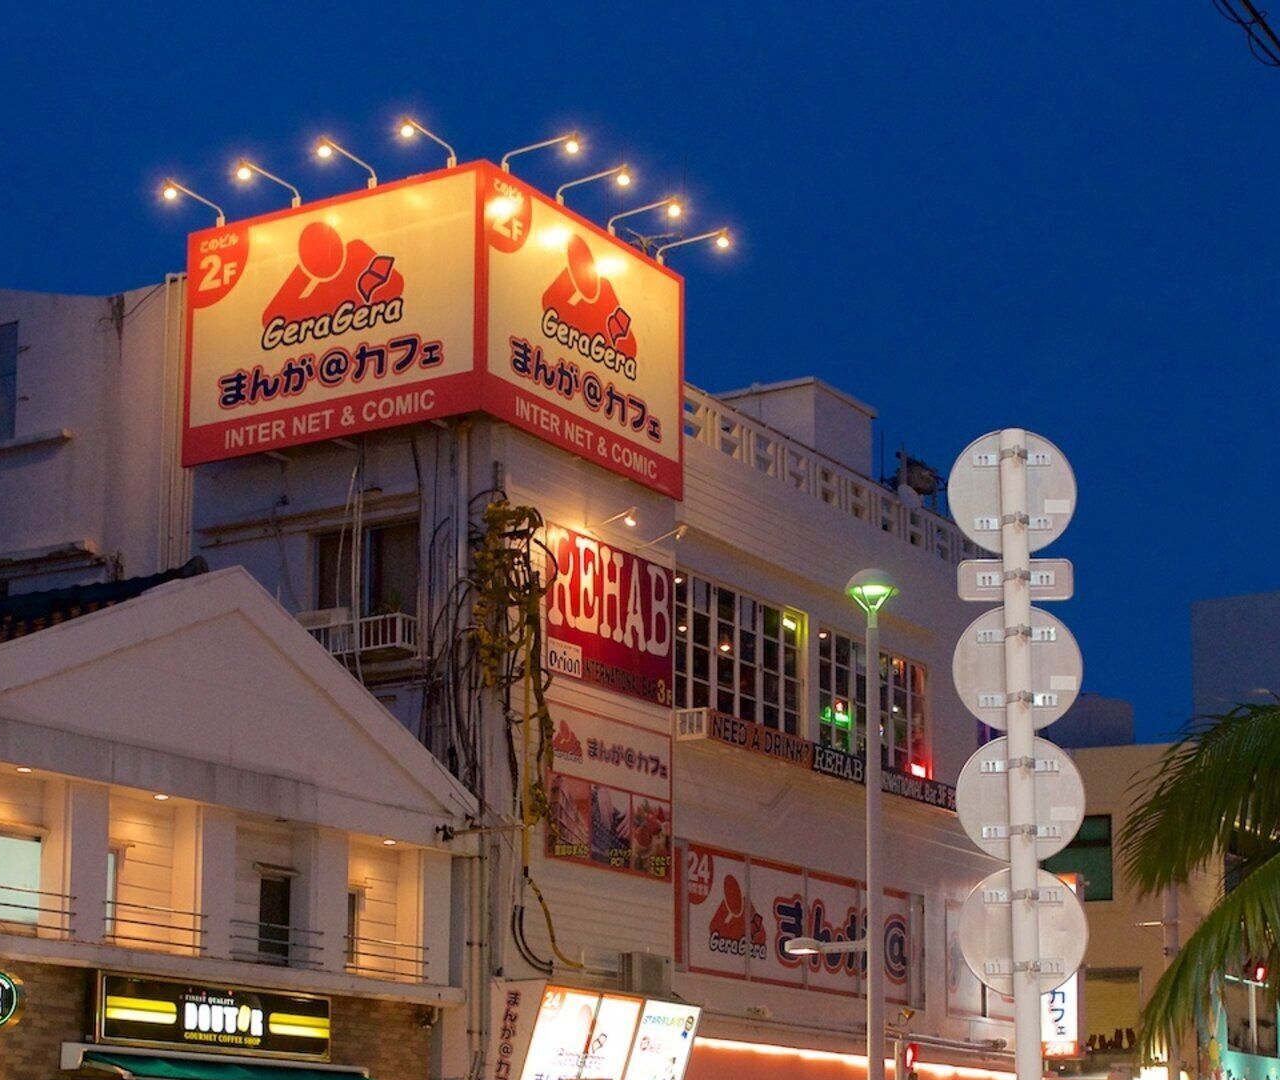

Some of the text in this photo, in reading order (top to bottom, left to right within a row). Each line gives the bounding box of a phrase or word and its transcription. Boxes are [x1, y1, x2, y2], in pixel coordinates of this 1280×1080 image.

[198, 256, 238, 292] 2F
[261, 297, 404, 350] GeraGera
[541, 307, 637, 382] GeraGera
[219, 333, 443, 408] まんが@カフェ
[509, 335, 662, 444] まんが@カフェ
[225, 389, 435, 450] INTER NET & COMIC
[515, 396, 658, 480] INTER NET & COMIC
[548, 526, 671, 657] REHAB
[712, 715, 747, 747] NEED
[751, 727, 761, 751] A
[586, 737, 668, 779] まんが@カフェ
[814, 745, 863, 783] REHAB
[688, 851, 709, 882] 24
[709, 931, 767, 960] GeraGera
[184, 1002, 264, 1037] DOUTOR
[545, 992, 561, 1008] 24
[1050, 990, 1066, 1036] カフェ
[184, 1031, 261, 1046] GOURMET COFFEE SHOP
